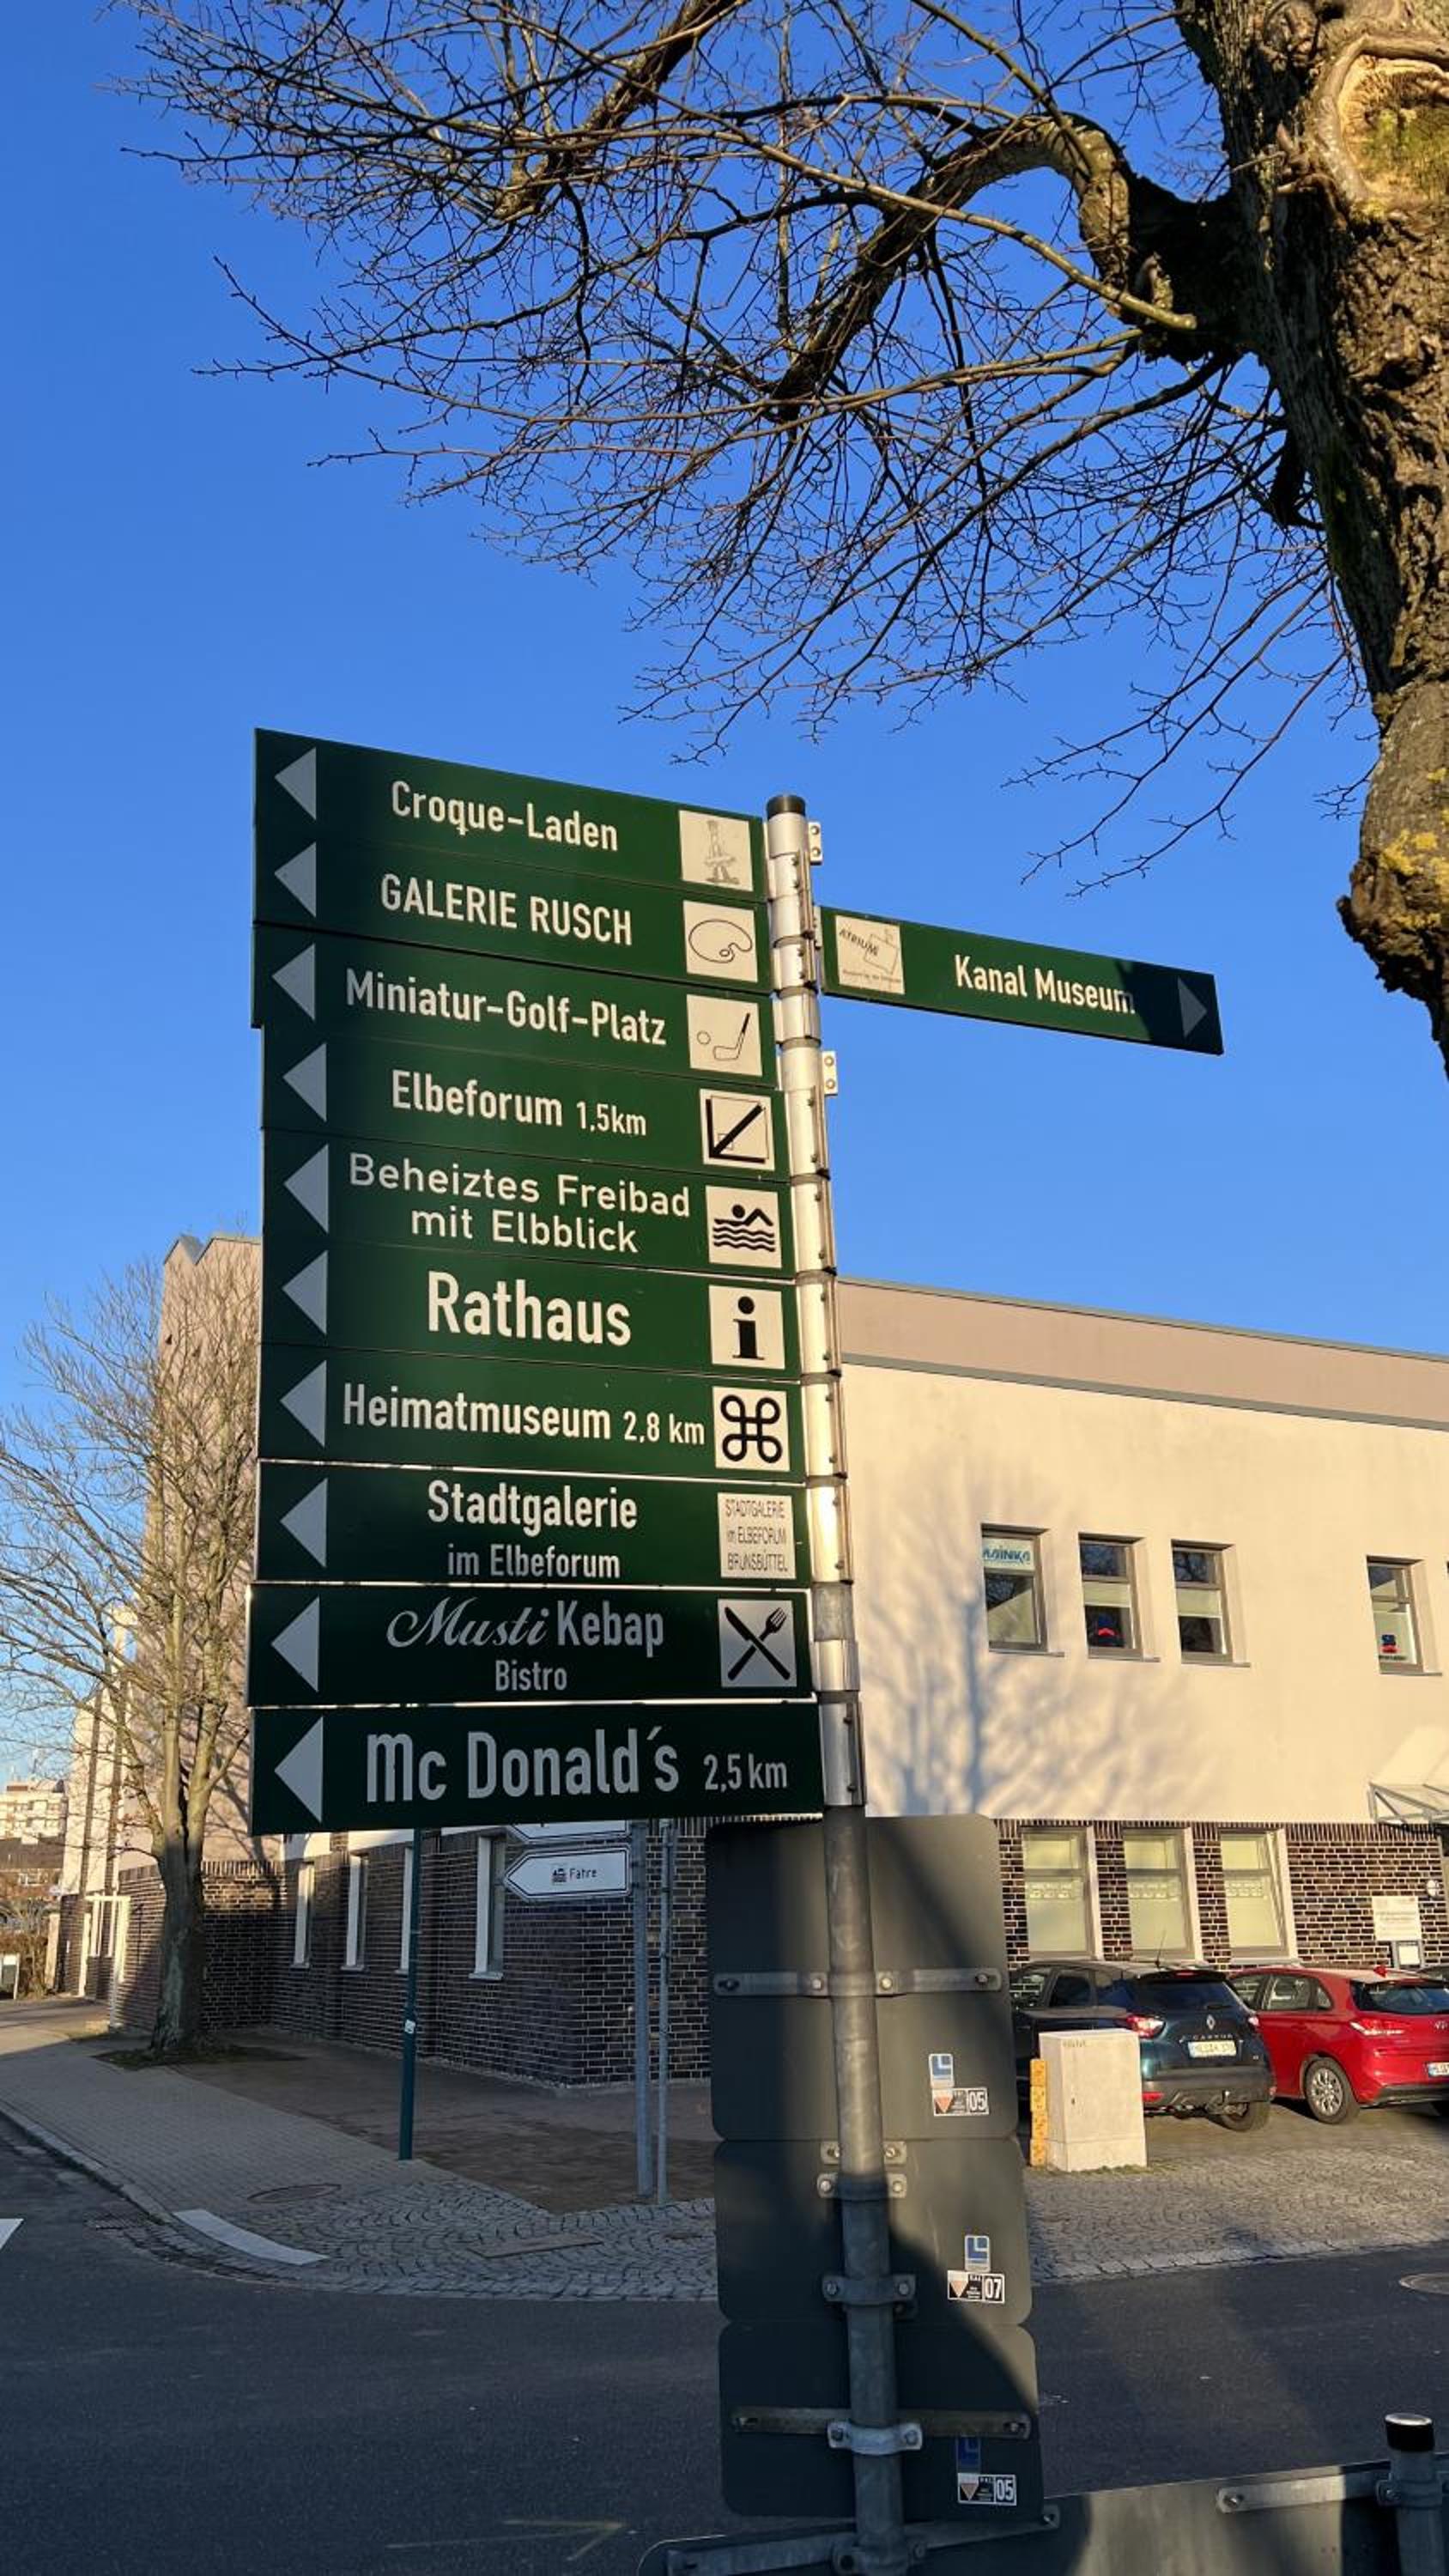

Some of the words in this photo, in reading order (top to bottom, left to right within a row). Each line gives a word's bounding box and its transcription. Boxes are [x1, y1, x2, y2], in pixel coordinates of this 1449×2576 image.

[391, 781, 619, 851] Croque-Laden
[381, 873, 518, 928] GALERIE
[530, 896, 633, 945] RUSCH
[346, 968, 667, 1046] Miniatur-Golf-Platz
[955, 955, 1028, 998] Kanal
[1034, 968, 1136, 1014] Museum
[392, 1069, 563, 1127] Elbeforum
[350, 1153, 540, 1203] Beheiztes
[557, 1174, 689, 1217] Freibad
[412, 1205, 473, 1239] mit
[492, 1209, 640, 1253] Elbblick
[427, 1271, 632, 1346] Rathaus
[343, 1382, 611, 1440] Heimatmuseum
[623, 1411, 660, 1443] 2,8
[669, 1413, 705, 1445] km
[427, 1479, 638, 1537] Stadtgalerie
[448, 1543, 479, 1576] im
[490, 1545, 621, 1579] Elbeforum
[386, 1596, 549, 1648] Musti
[556, 1607, 664, 1657] Kebap
[495, 1659, 568, 1692] Bistro
[969, 2091, 985, 2111] 05
[985, 2277, 1003, 2300] 07
[997, 2478, 1014, 2501] 05
